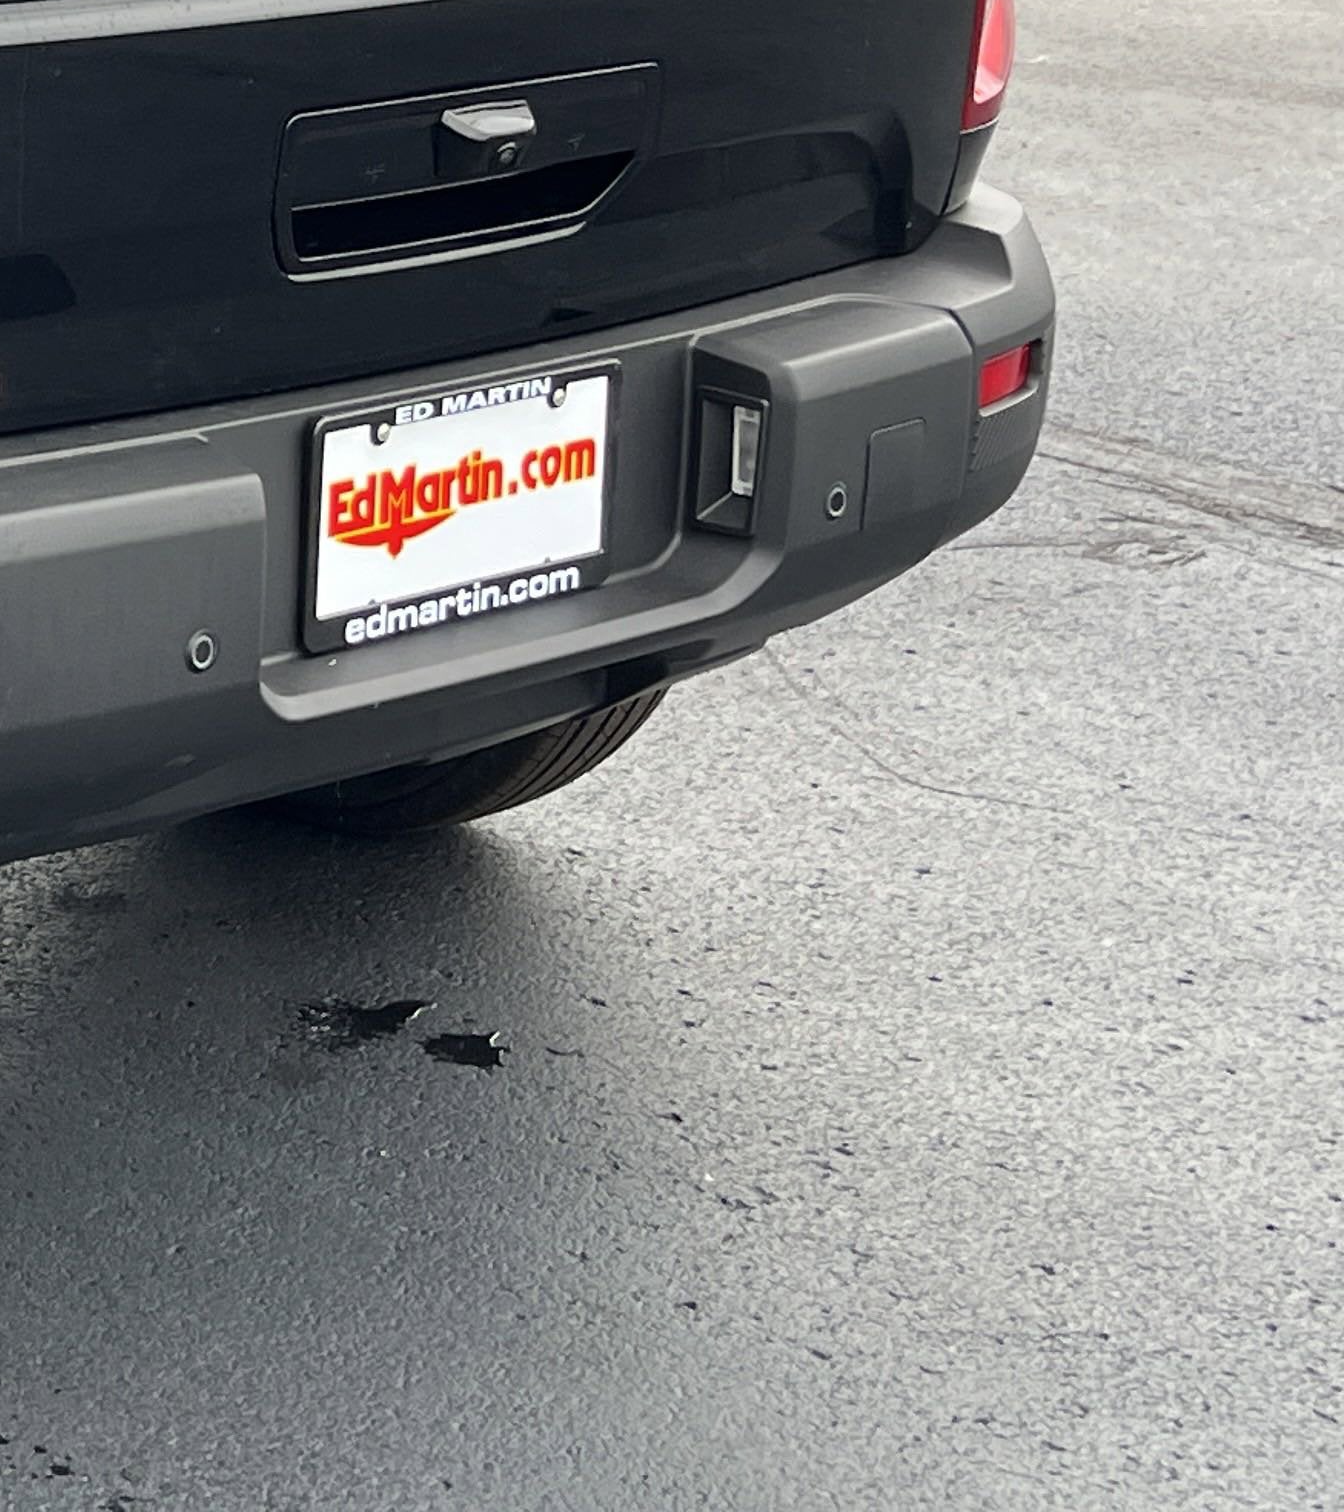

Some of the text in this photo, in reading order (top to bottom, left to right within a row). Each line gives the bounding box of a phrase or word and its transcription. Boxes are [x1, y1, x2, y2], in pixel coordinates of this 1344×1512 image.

[395, 376, 552, 425] ED MARTIN
[344, 566, 580, 644] edmartin.com
